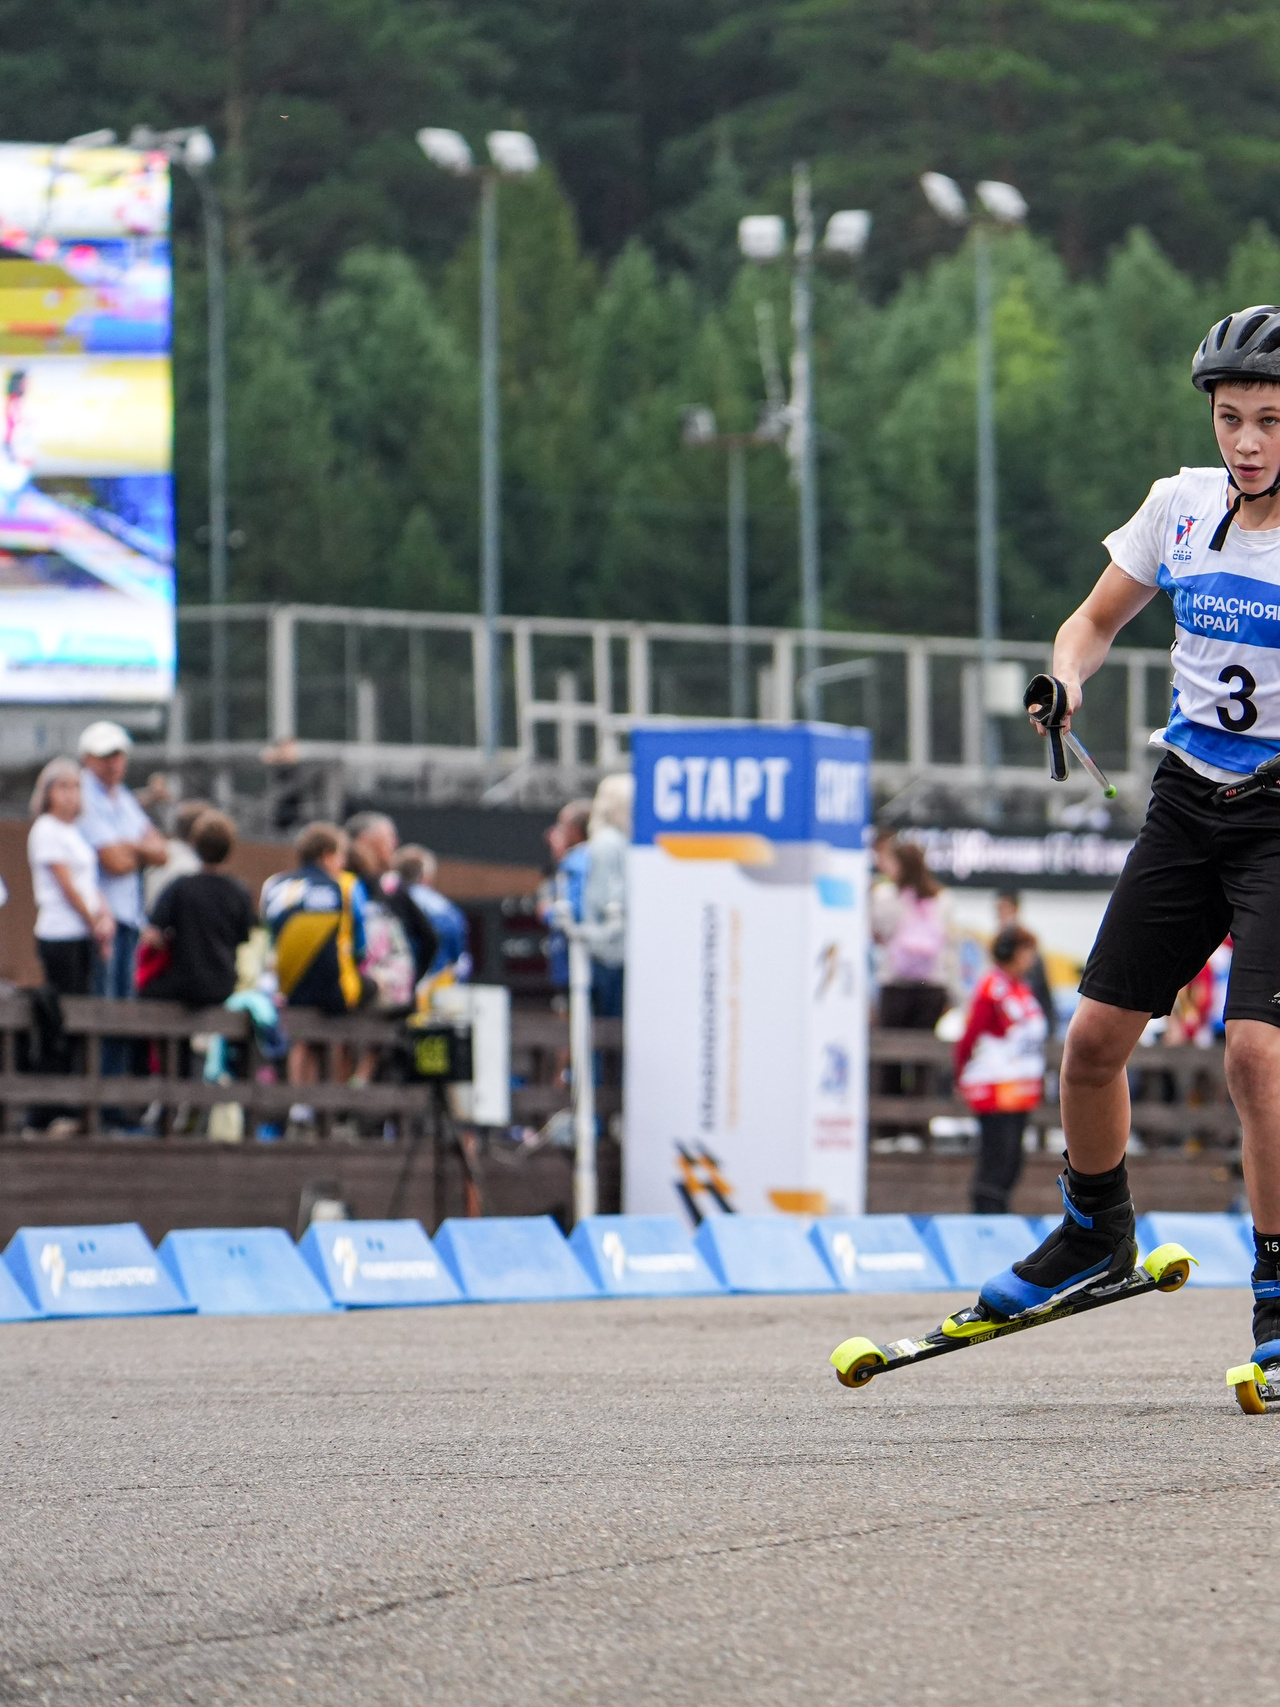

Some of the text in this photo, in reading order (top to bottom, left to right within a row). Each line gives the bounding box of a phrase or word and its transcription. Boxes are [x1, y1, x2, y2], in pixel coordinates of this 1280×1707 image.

[1172, 553, 1192, 561] СБР
[1193, 612, 1239, 634] КРАЙ
[1216, 664, 1258, 732] 3
[653, 755, 791, 823] СТАРТ
[968, 1330, 997, 1346] START
